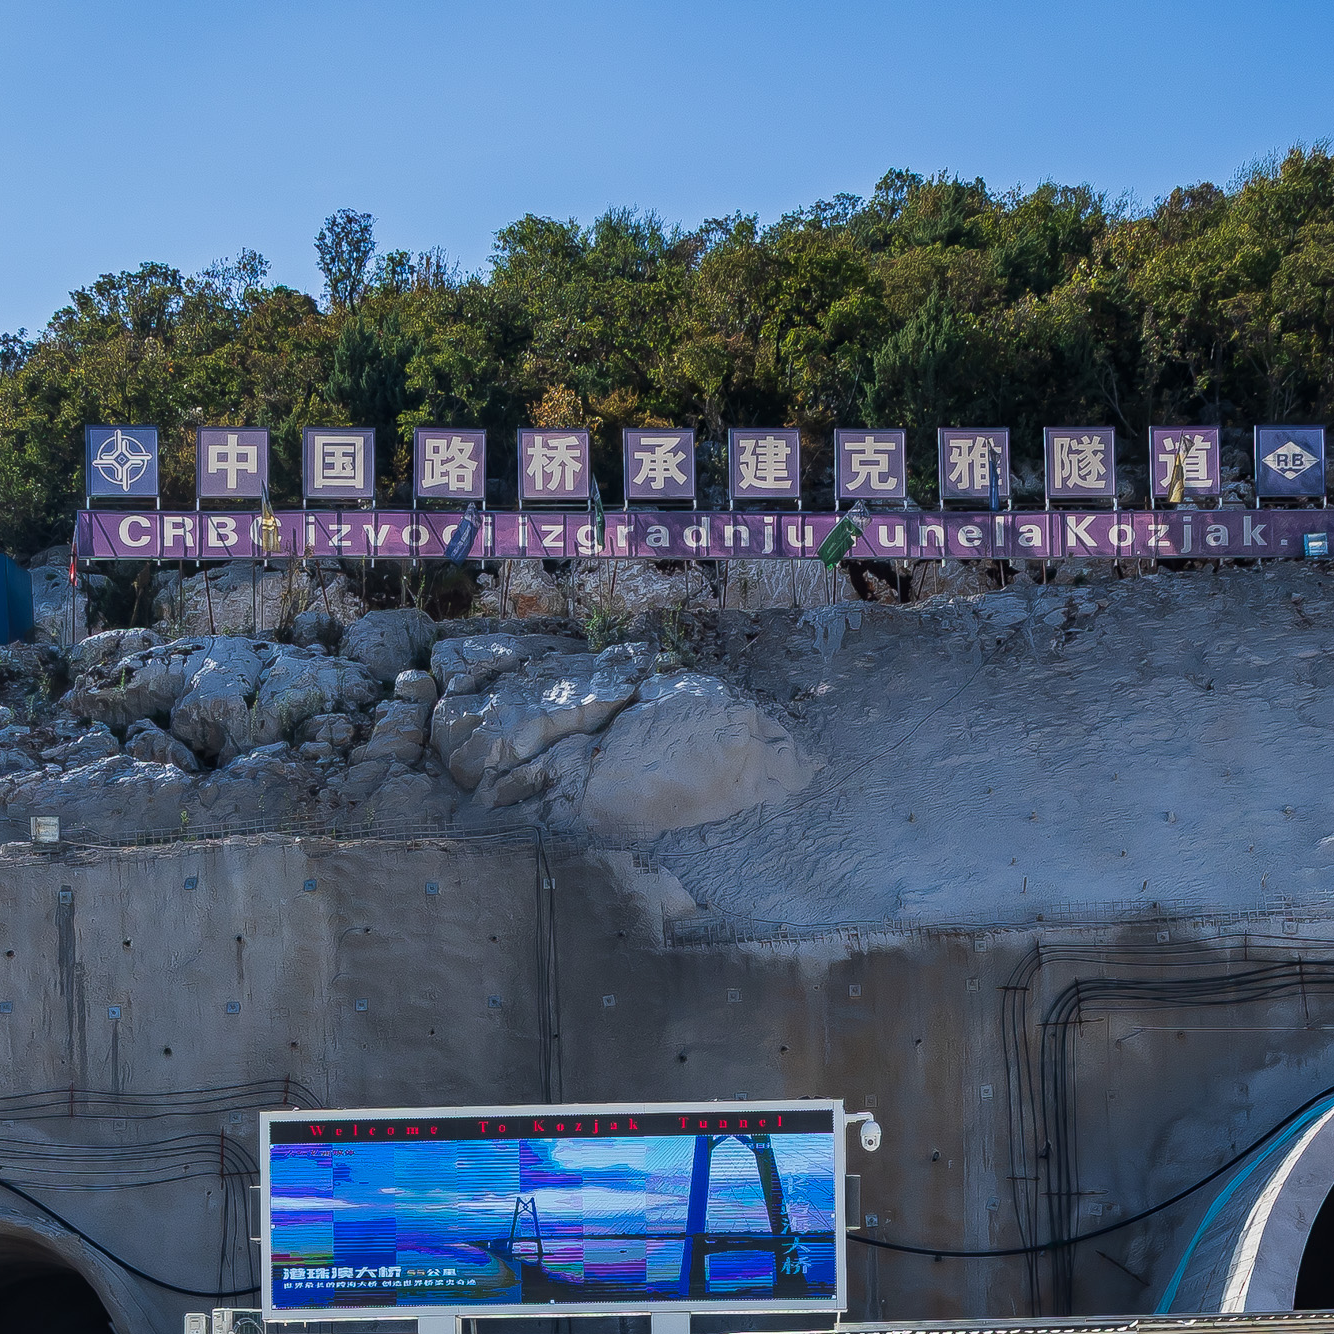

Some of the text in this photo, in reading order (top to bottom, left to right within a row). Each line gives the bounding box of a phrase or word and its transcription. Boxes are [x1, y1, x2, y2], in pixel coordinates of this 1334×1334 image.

[207, 434, 1213, 492] 中国路桥承建克雅隧道
[118, 515, 282, 548] CRBC
[519, 515, 814, 554] izgradnju
[309, 1115, 782, 1136] Welcome To Kozjak Tunnel
[282, 1266, 402, 1280] 港珠澳大桥
